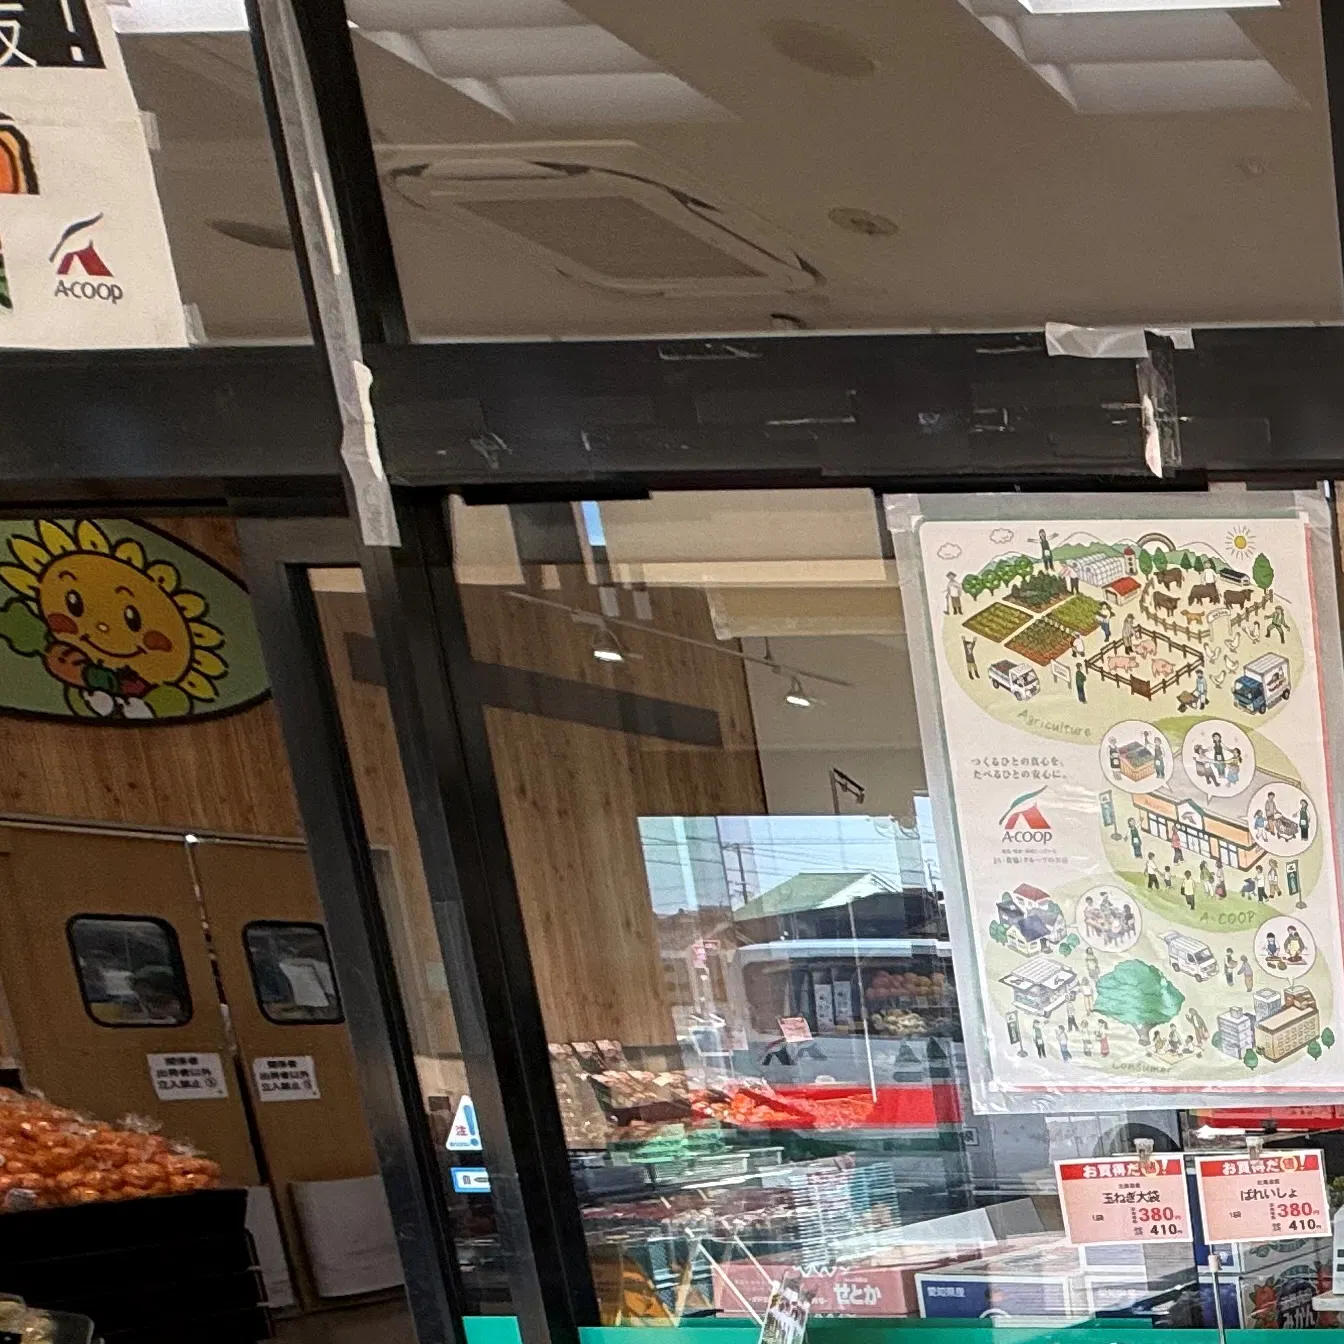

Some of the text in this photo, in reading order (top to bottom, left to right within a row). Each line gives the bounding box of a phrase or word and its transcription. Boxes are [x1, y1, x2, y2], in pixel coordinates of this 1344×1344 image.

[1017, 709, 1092, 737] Agriculture
[973, 769, 1068, 780] たべるひとの安心に。
[1102, 1190, 1161, 1205] 玉ねぎ大袋
[1240, 1187, 1299, 1201] ばれいしょ
